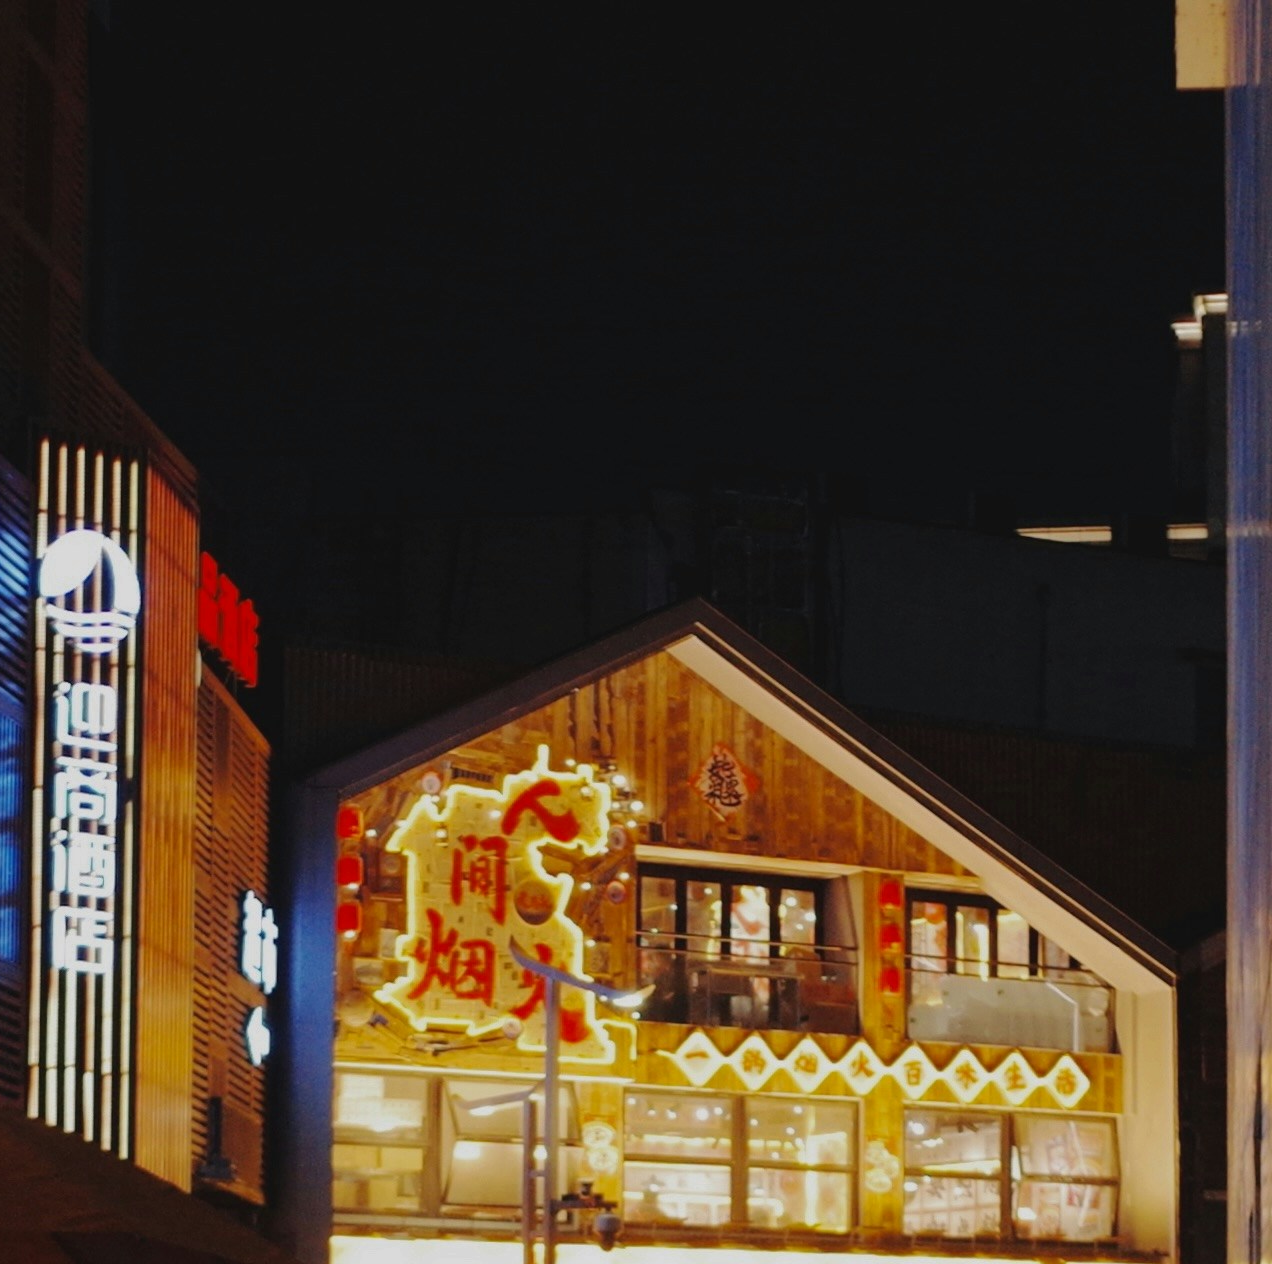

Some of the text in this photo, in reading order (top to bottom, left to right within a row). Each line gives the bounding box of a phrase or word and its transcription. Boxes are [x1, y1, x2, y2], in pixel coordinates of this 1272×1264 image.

[52, 681, 119, 975] 迎商酒店
[408, 778, 590, 1044] 人间烟火
